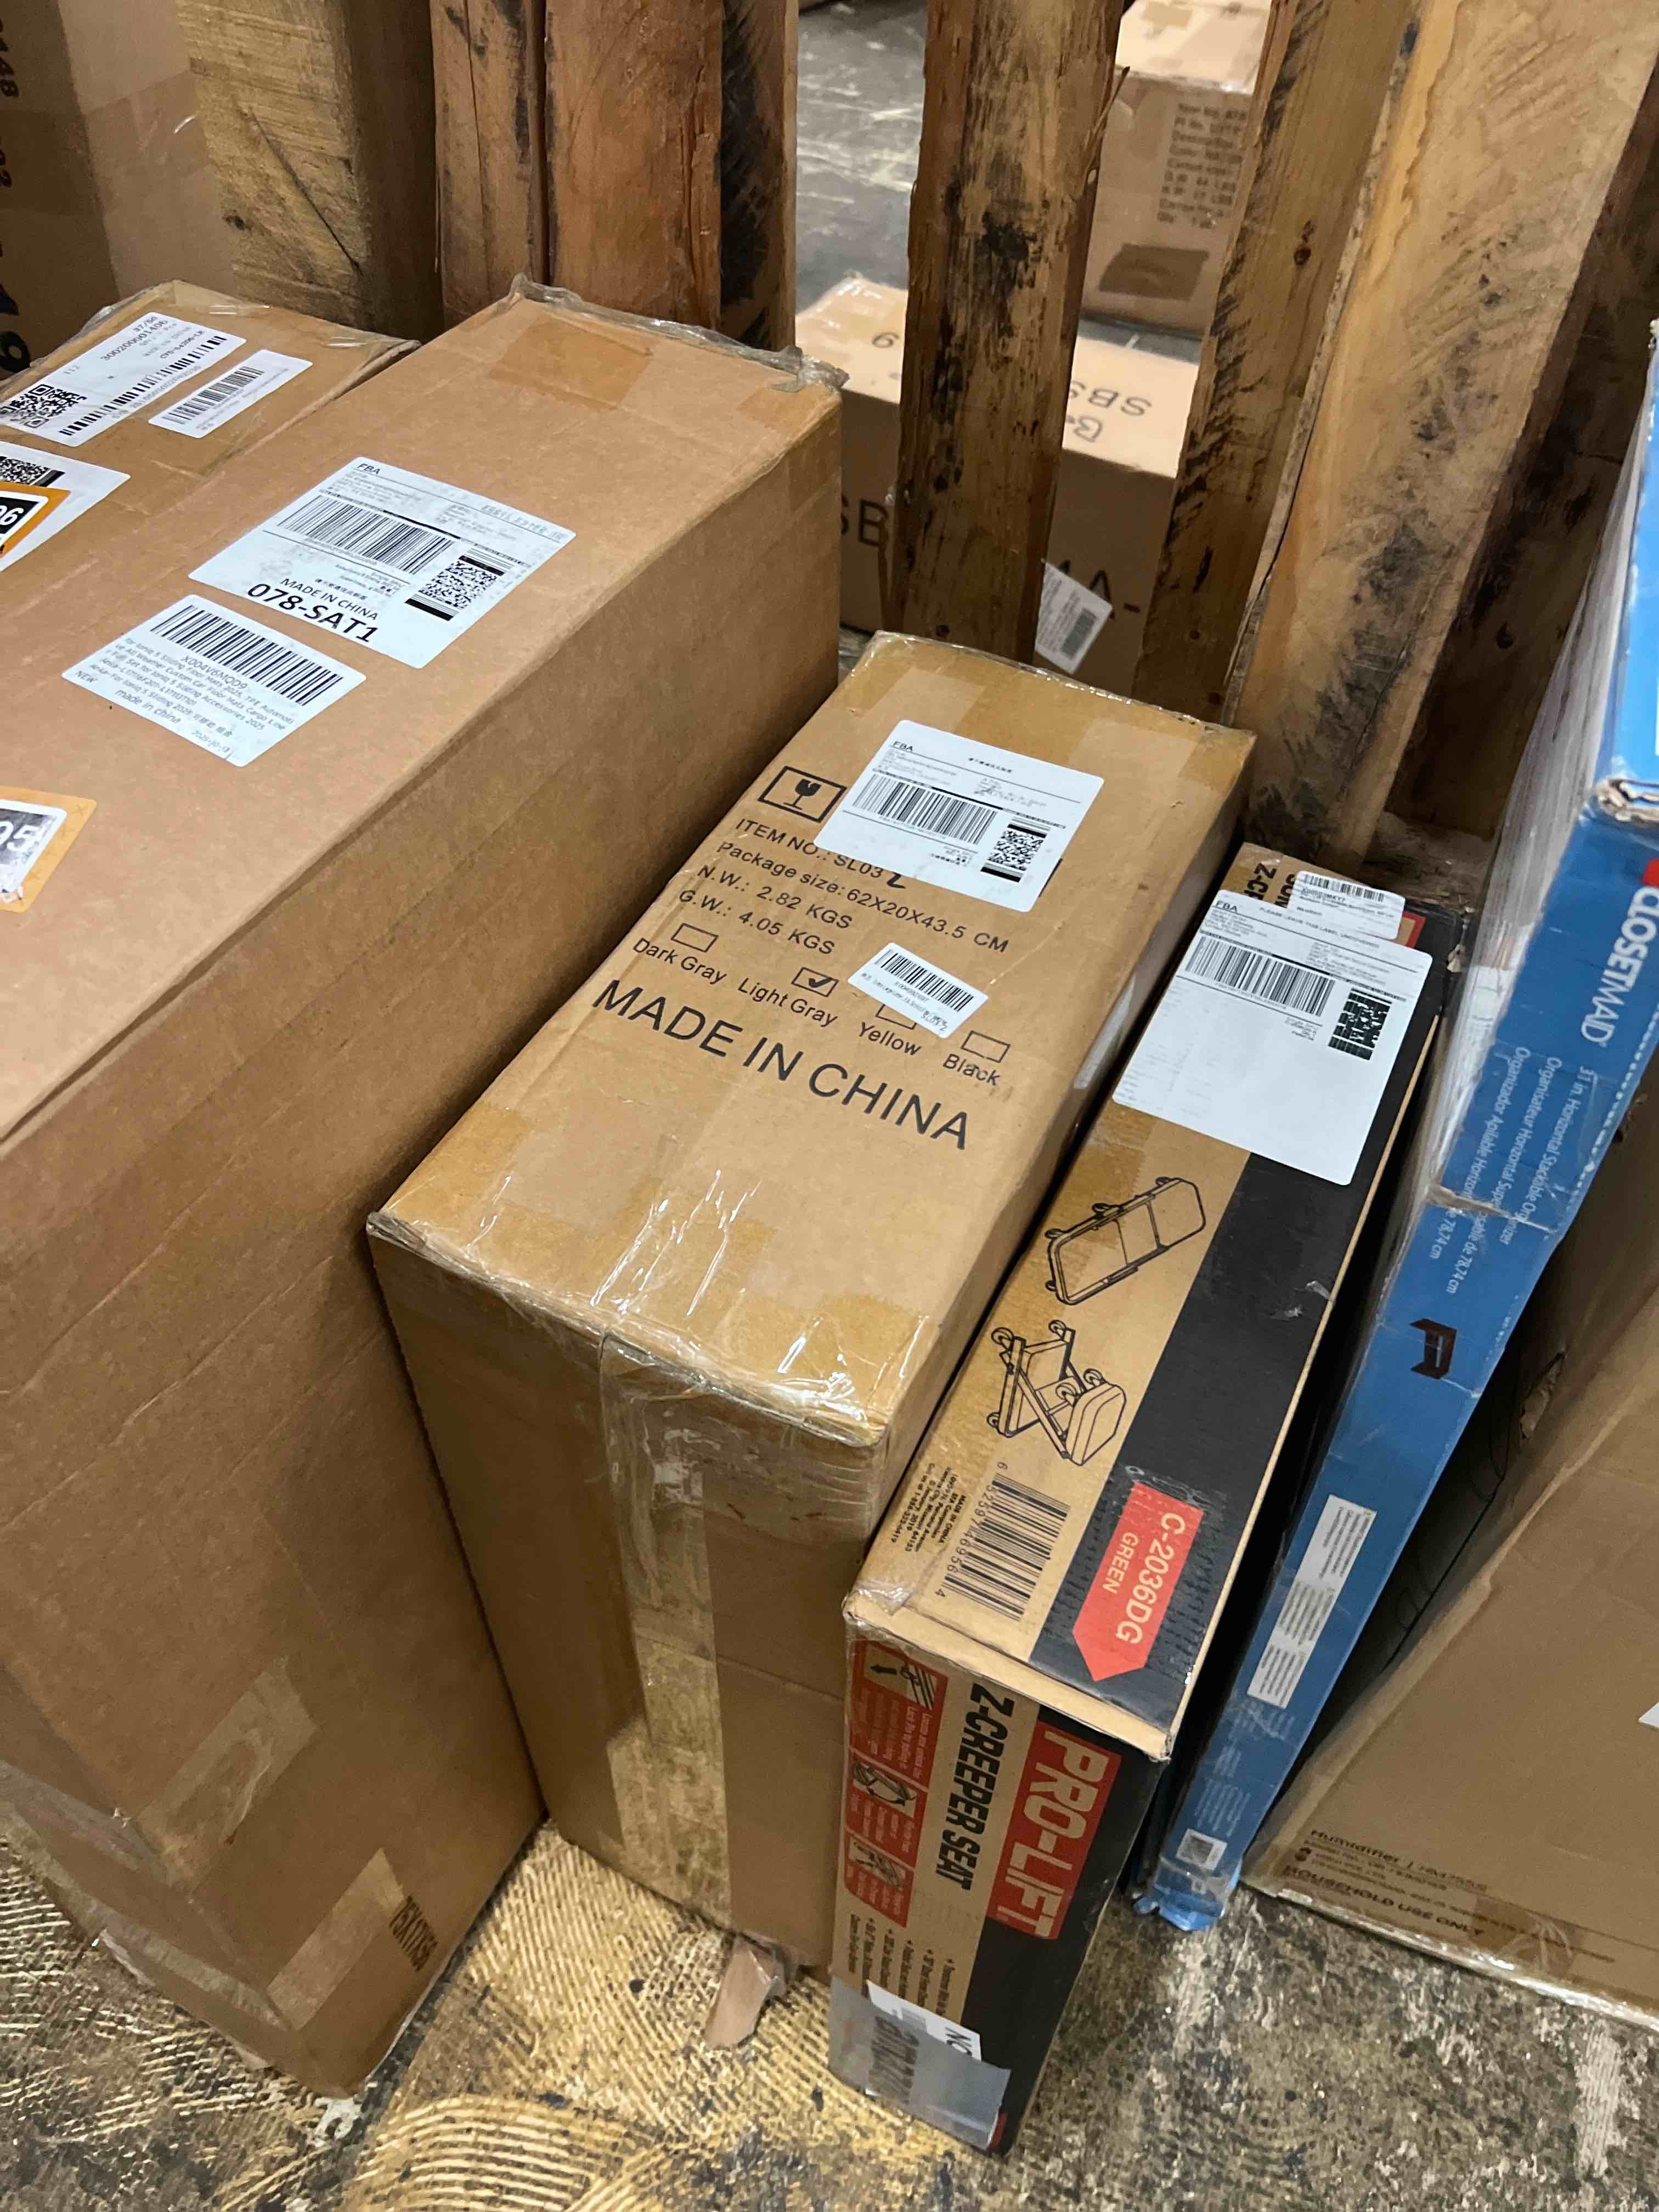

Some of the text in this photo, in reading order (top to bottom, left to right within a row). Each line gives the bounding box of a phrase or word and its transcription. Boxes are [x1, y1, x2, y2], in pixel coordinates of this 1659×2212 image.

[356, 462, 383, 475] FBA
[244, 580, 383, 642] 078-SAT1
[279, 577, 322, 597] MADE
[318, 592, 338, 603] IN
[334, 599, 382, 621] CHINA
[72, 669, 99, 684] NEW
[113, 689, 144, 706] made
[140, 702, 156, 711] in
[151, 707, 183, 725] china
[891, 740, 916, 752] FBA
[735, 818, 787, 844] ITEM
[786, 836, 831, 861] NO.:
[679, 889, 836, 955] G.W.: 4.05 KGS
[716, 841, 1010, 953] Package size: 62X20X43.5 CM
[757, 885, 802, 910] 2.82
[805, 904, 853, 929] KGS
[1215, 899, 1240, 913] FBA
[632, 938, 728, 985] Dark Gray
[1581, 886, 1659, 1044] CLOSETMAID
[737, 977, 789, 1008] Light
[790, 997, 839, 1028] Gray
[592, 979, 969, 1151] MADE IN CHINA
[858, 1021, 922, 1058] Yellow
[942, 1053, 1002, 1089] Black
[1494, 1046, 1531, 1114] Organizador
[1522, 1056, 1562, 1129] Organisateur
[1480, 1114, 1504, 1160] Apilable
[1547, 1097, 1582, 1156] Horizontal
[1502, 1128, 1533, 1183] Horizontal
[1528, 1152, 1557, 1204] Stackable
[1463, 1240, 1478, 1255] de
[1499, 1201, 1537, 1245] Orgnizer
[1429, 1244, 1444, 1260] cm
[1446, 1280, 1460, 1295] cm
[997, 1461, 1009, 1471] 6
[1102, 1531, 1139, 1594] GREEN
[1115, 1512, 1186, 1645] C-2036DG
[935, 1683, 1014, 1891] Z-CREEPER SEAT
[996, 1729, 1109, 1938] PRO-LIFT
